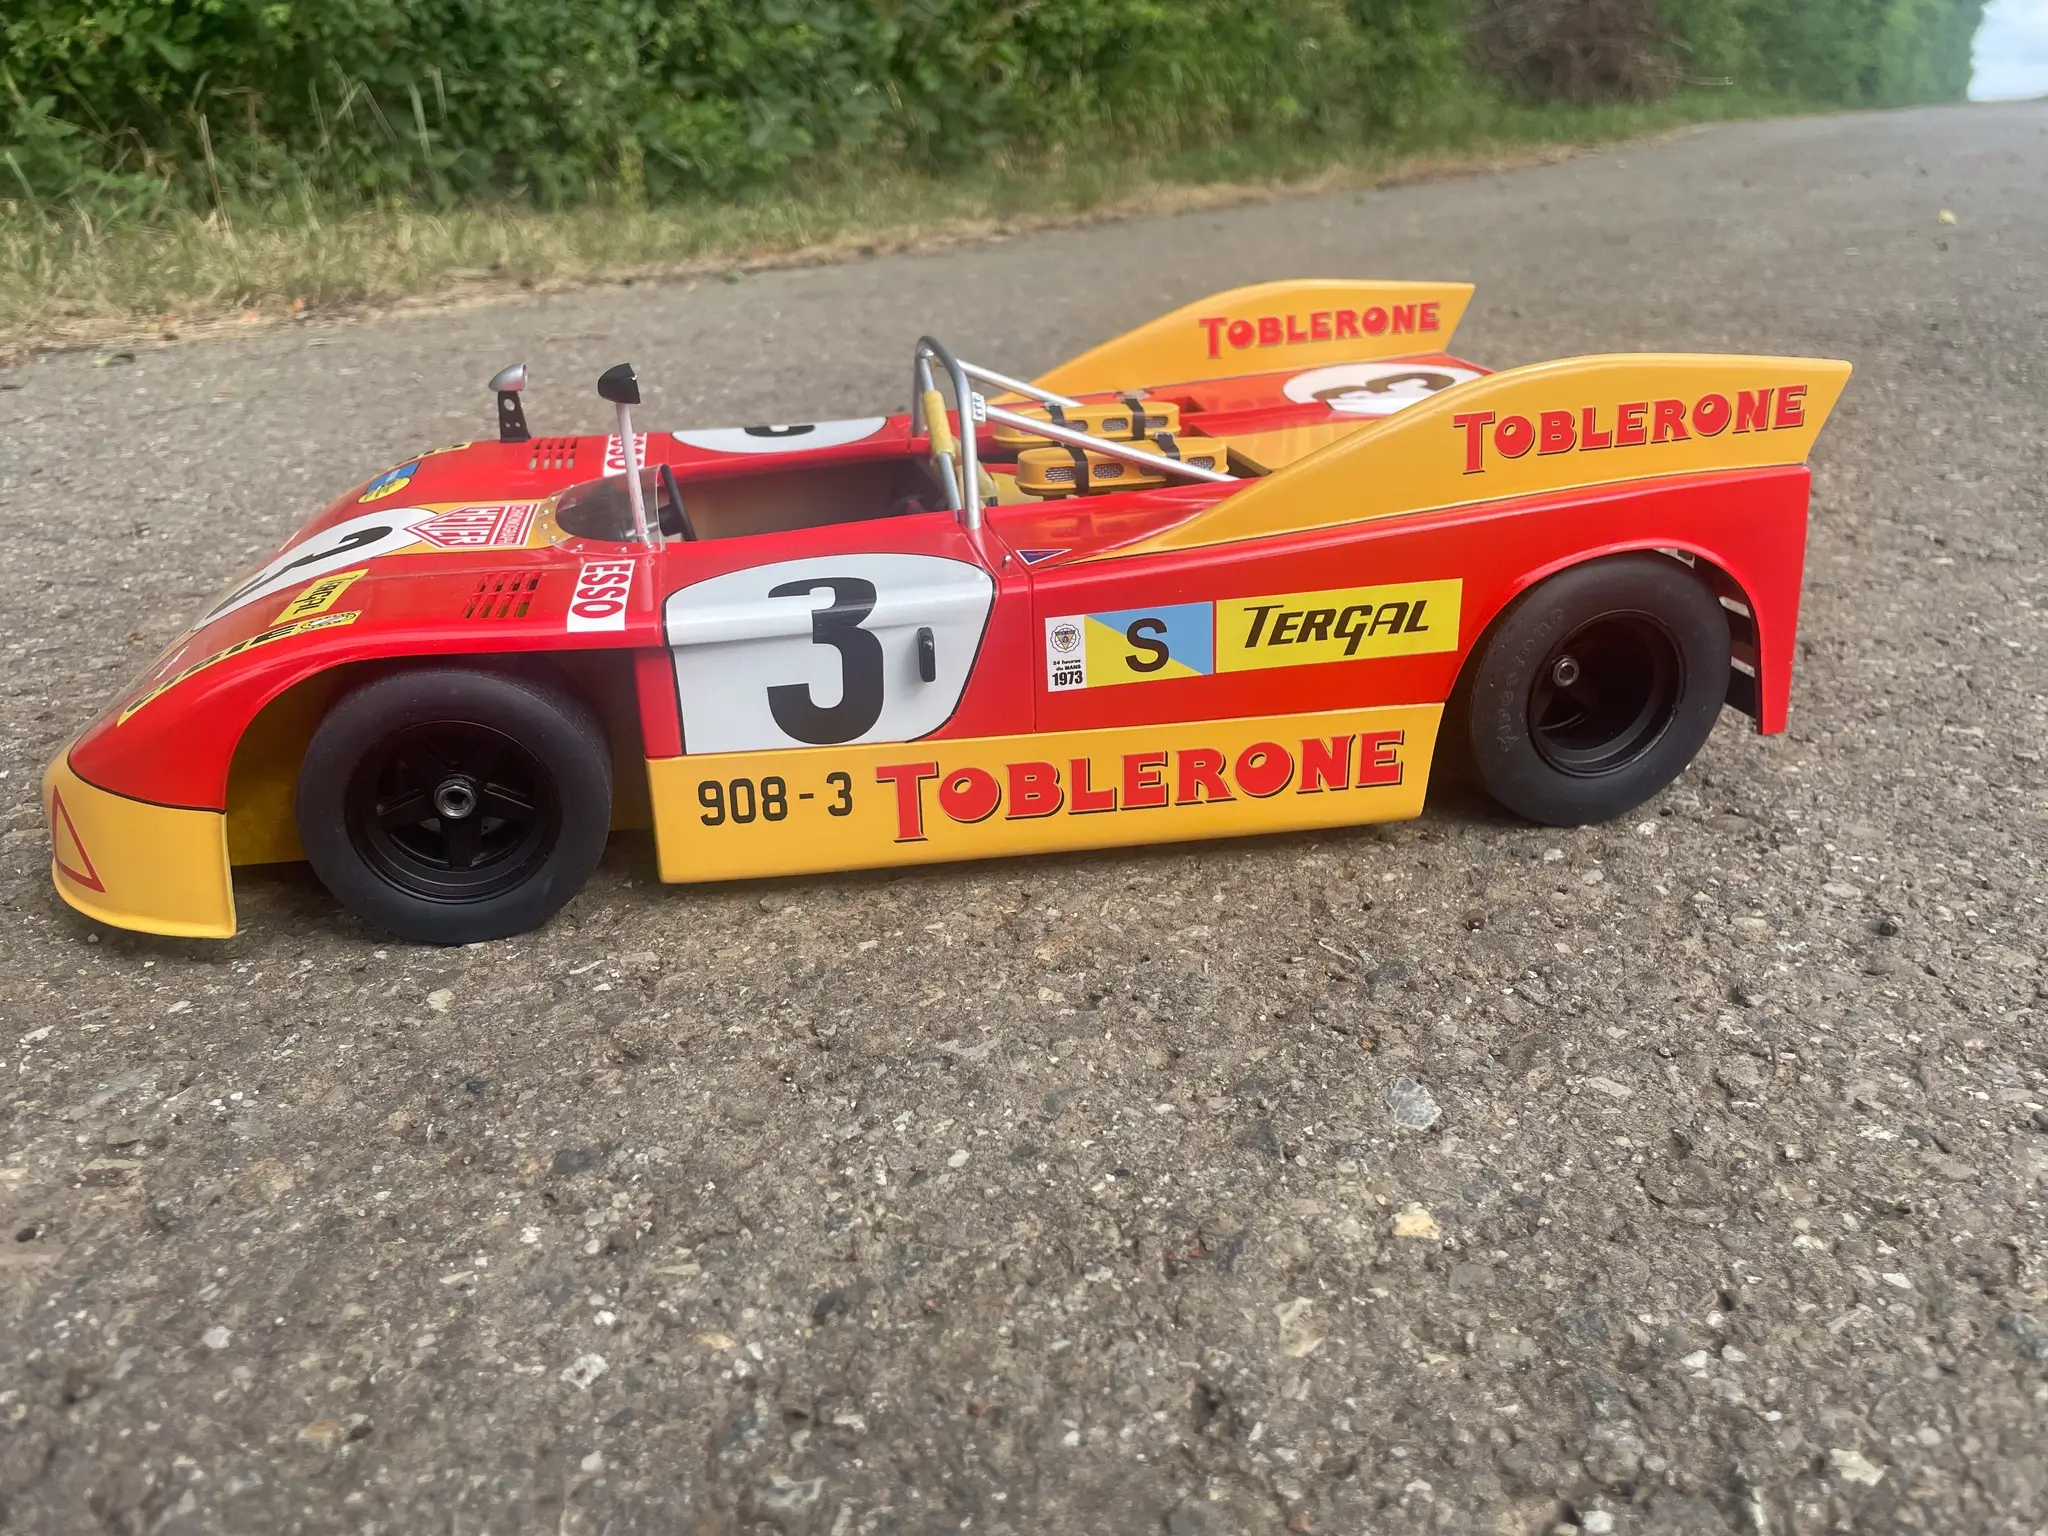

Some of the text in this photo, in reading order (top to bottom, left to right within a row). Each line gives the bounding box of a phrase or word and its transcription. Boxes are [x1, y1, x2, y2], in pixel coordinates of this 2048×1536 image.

[1198, 302, 1440, 360] TOBLERONE
[1453, 384, 1808, 475] TOBLERONE
[417, 507, 501, 545] HEUER
[571, 563, 632, 619] ESSO
[1124, 618, 1170, 674] S
[1243, 600, 1430, 656] TERGAL
[766, 576, 885, 745] 3
[1052, 670, 1083, 687] 1973
[875, 729, 1405, 843] TOBLERONE
